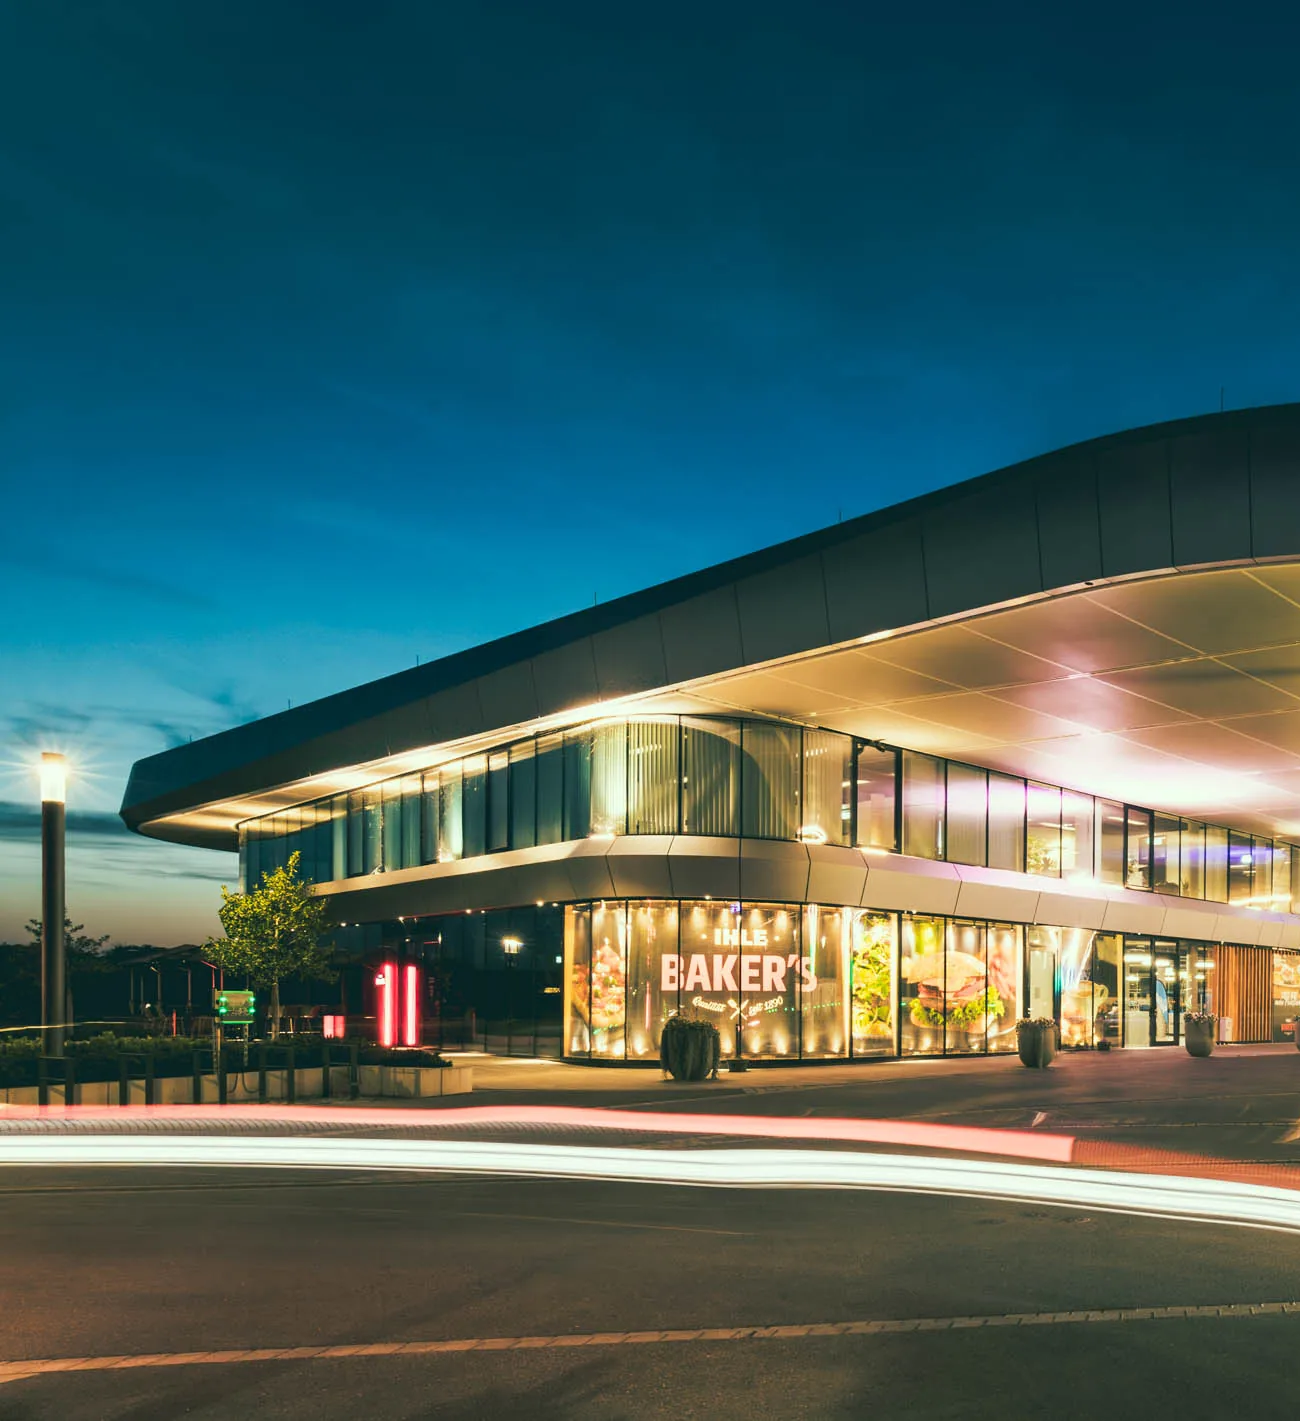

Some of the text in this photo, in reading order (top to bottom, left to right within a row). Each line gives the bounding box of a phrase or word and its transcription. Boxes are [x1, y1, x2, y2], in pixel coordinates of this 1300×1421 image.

[713, 928, 769, 946] IHLE
[660, 953, 818, 993] BAKER'S
[764, 995, 784, 1011] 1890
